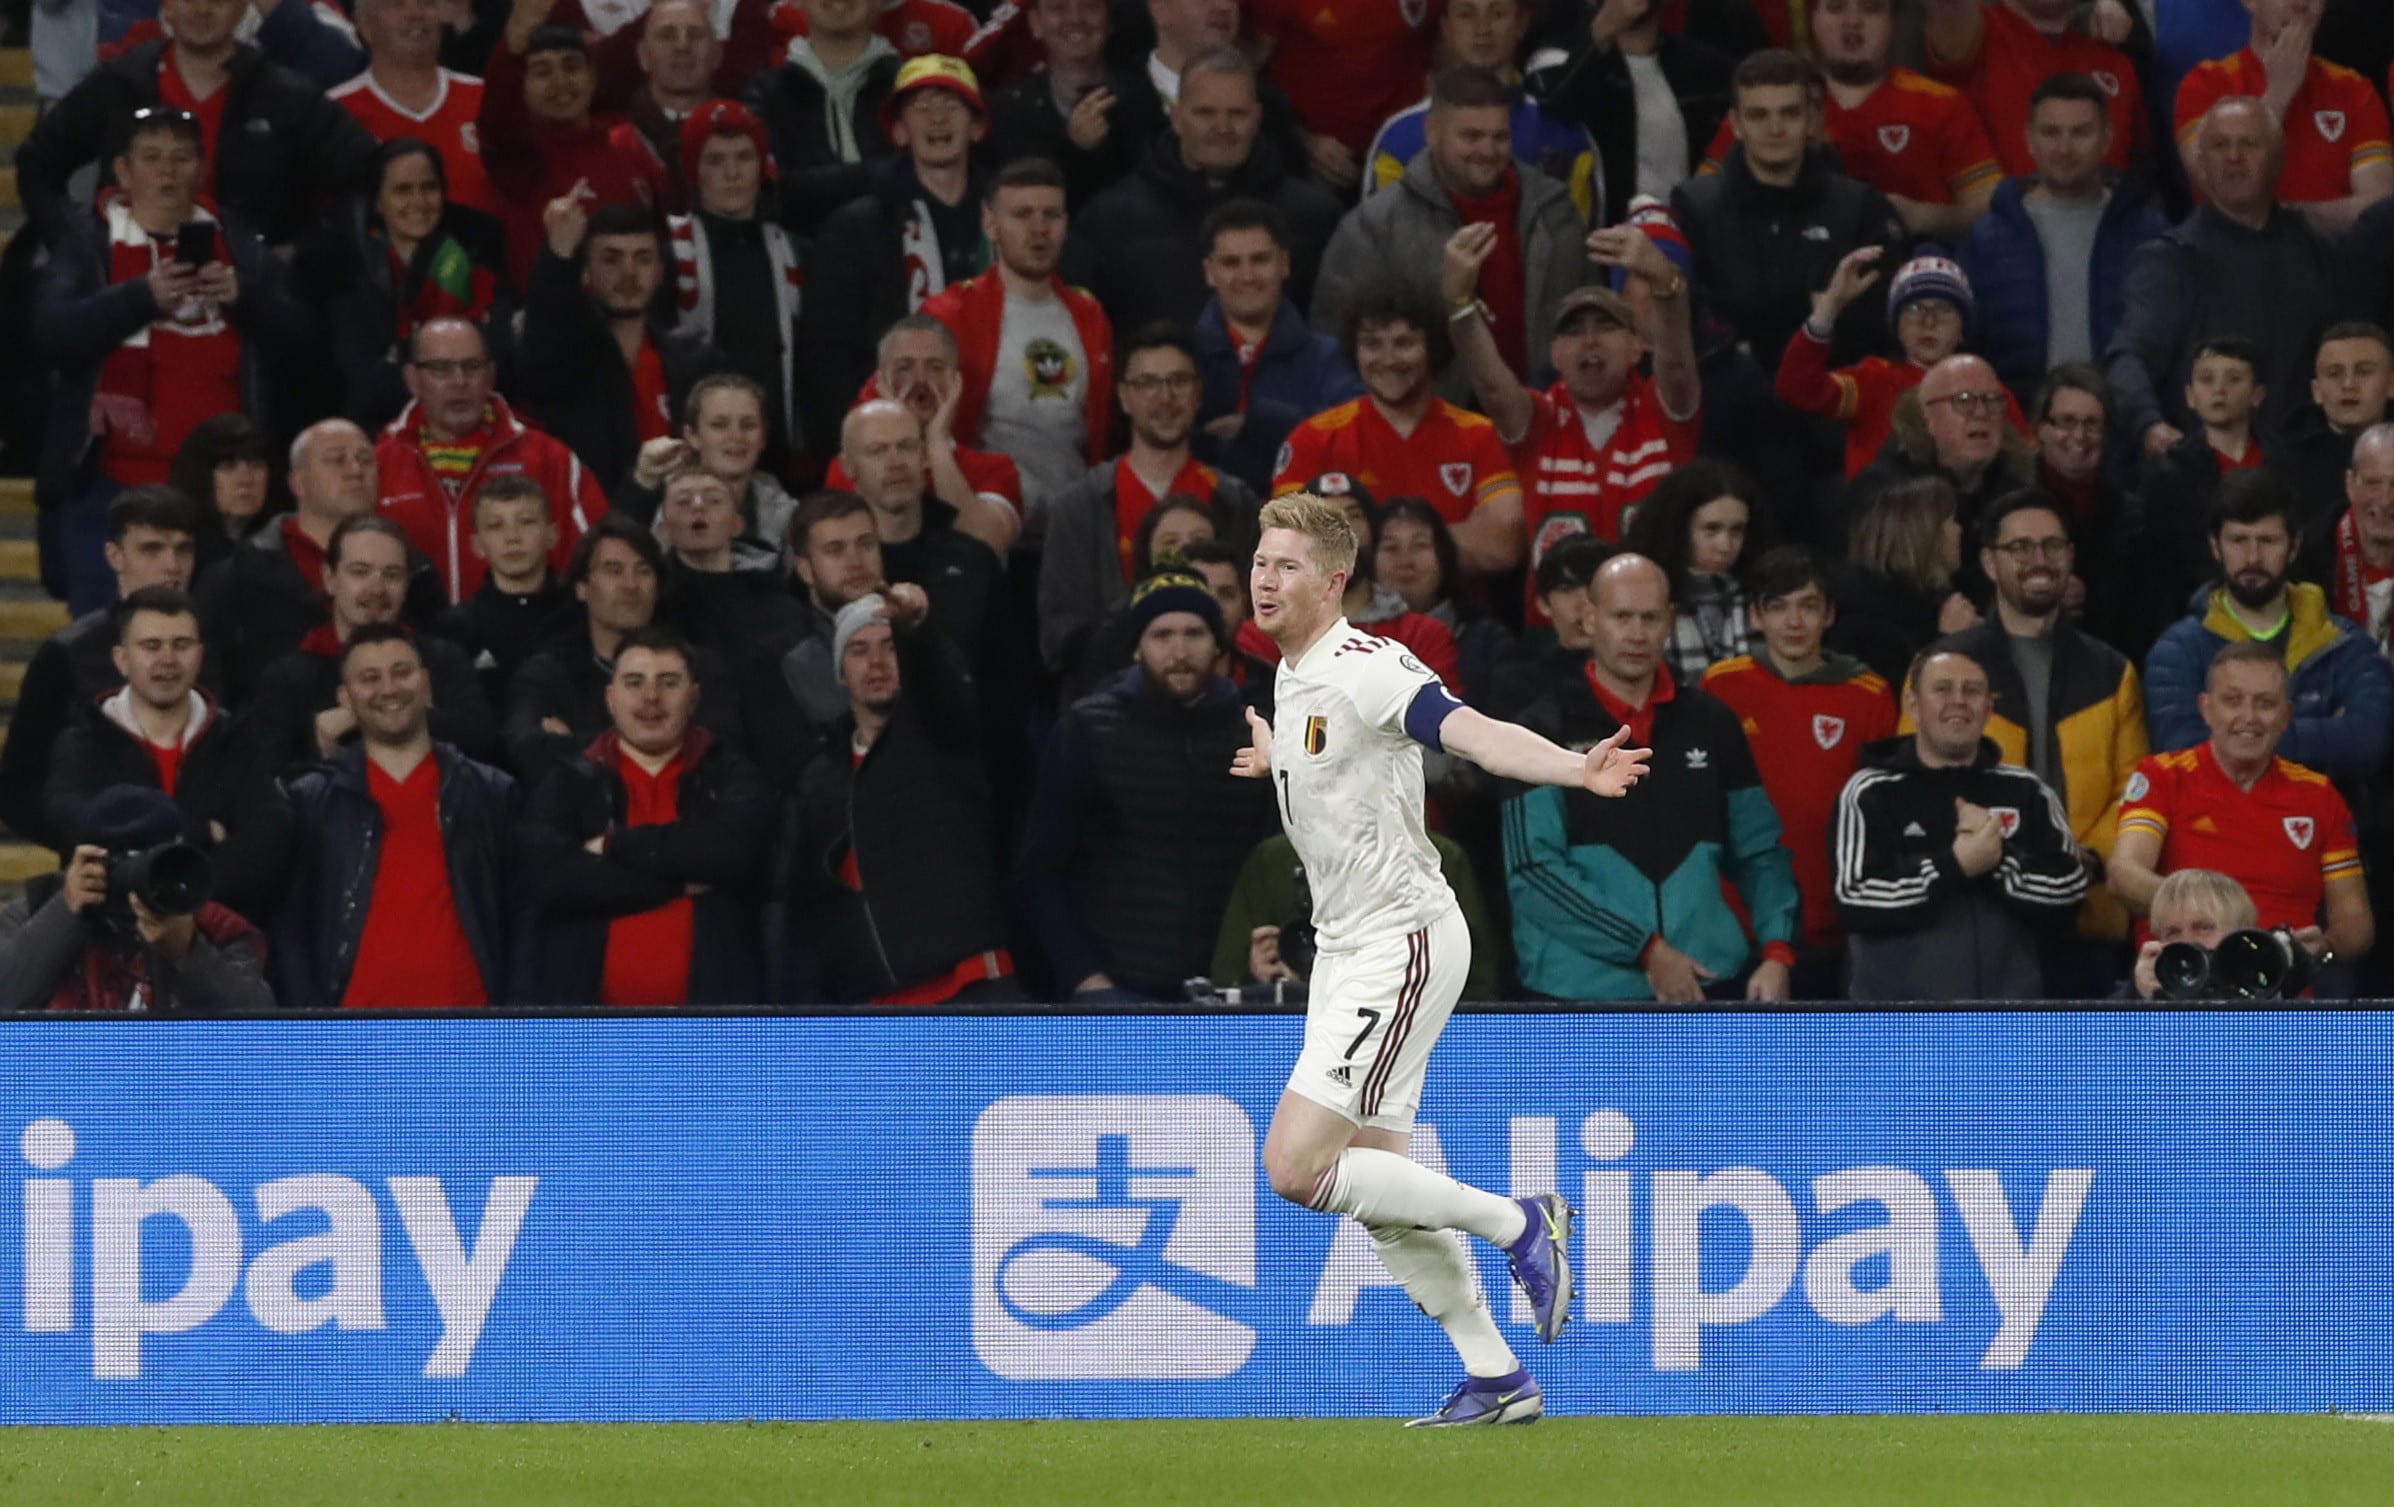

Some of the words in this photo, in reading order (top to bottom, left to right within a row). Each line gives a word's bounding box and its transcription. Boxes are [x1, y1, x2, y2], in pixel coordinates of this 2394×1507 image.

[1279, 769, 1293, 825] 7
[1343, 1006, 1381, 1061] 7
[20, 1117, 540, 1379] ipay
